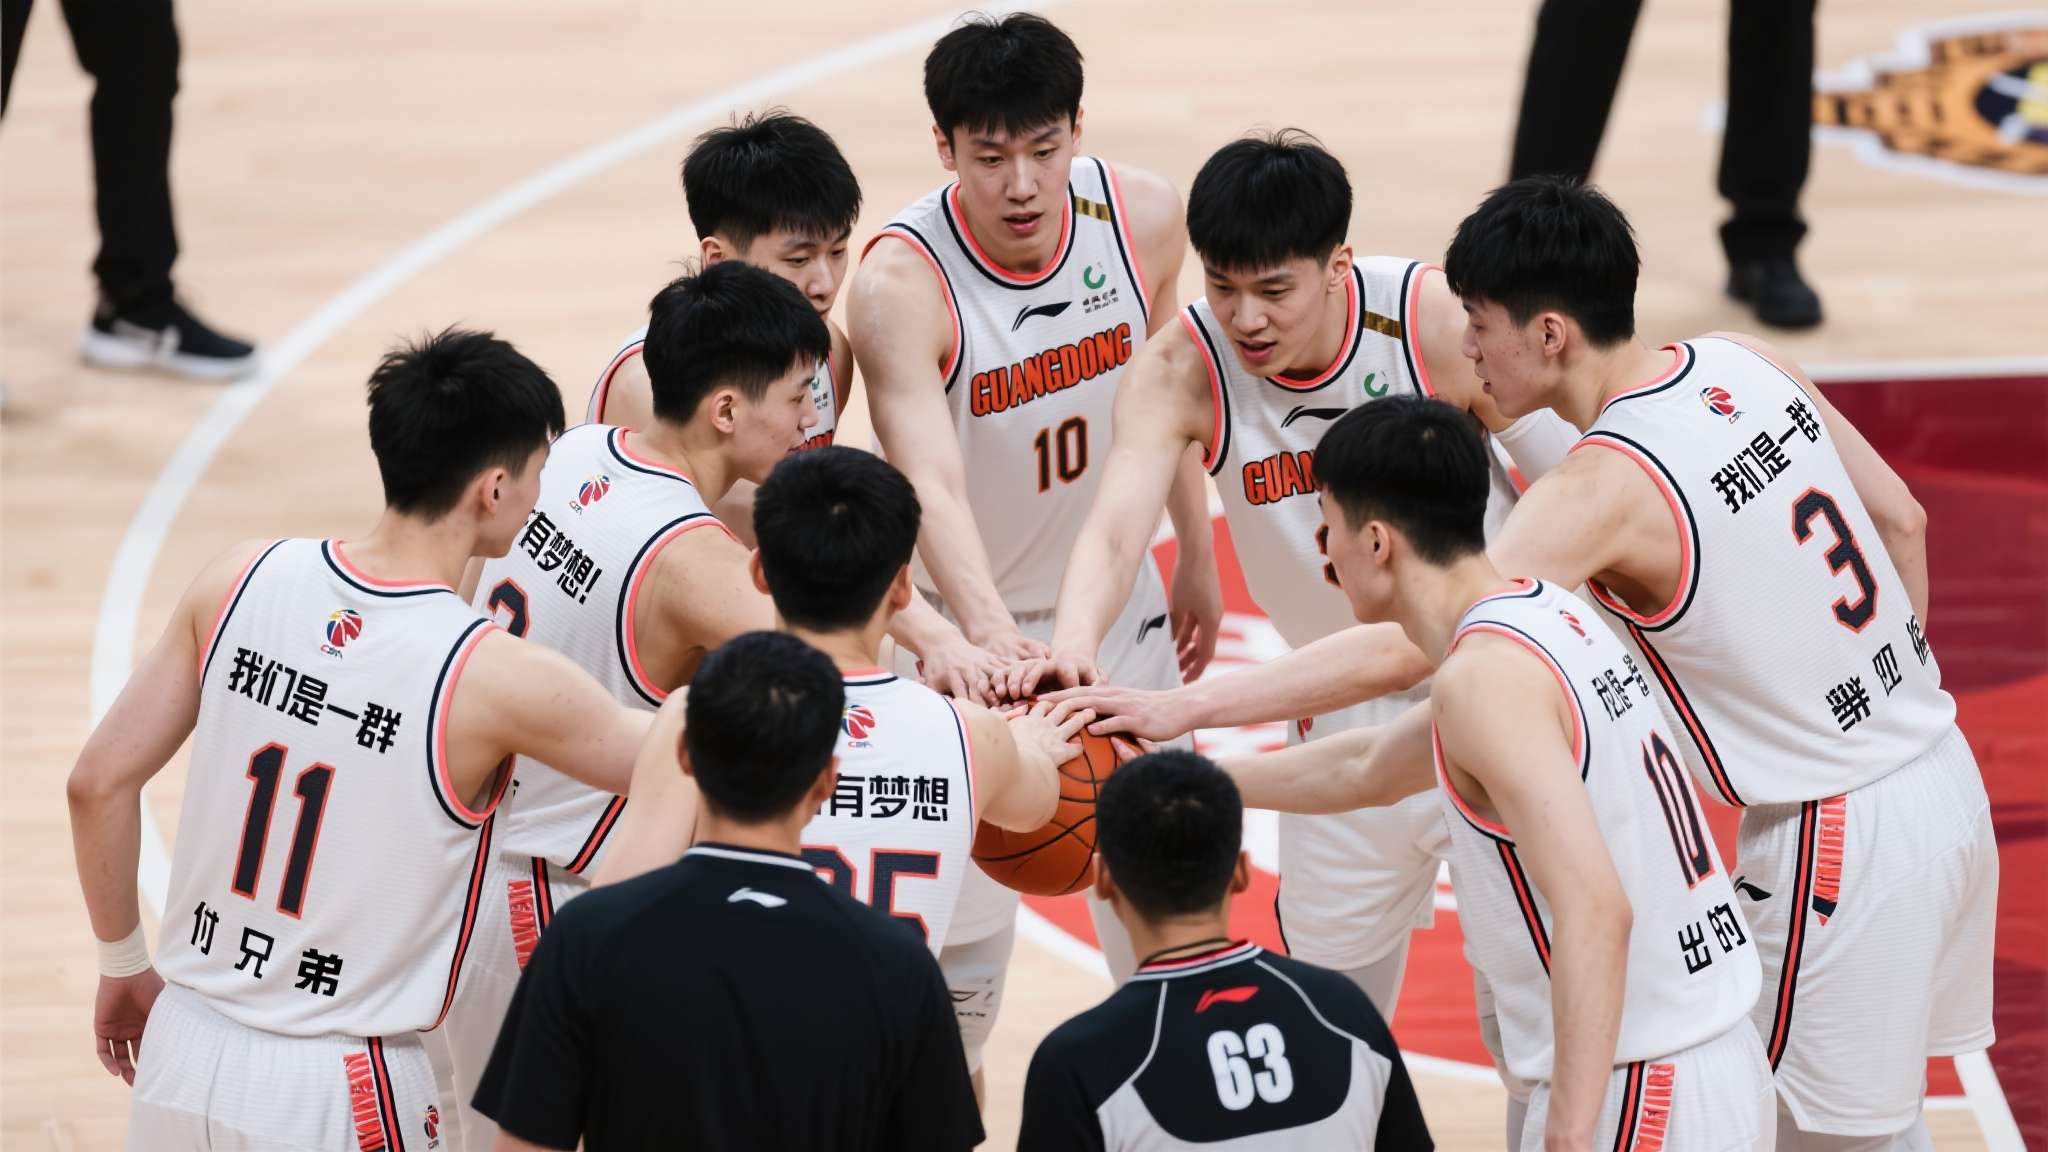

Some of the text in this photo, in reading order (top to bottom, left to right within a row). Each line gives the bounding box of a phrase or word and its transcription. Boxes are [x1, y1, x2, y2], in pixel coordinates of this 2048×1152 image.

[970, 322, 1132, 417] GUANGDONG
[1034, 416, 1088, 494] 10
[1710, 397, 1821, 514] 我们是一群
[1791, 486, 1879, 634] 3
[228, 647, 402, 754] 我们是一群
[231, 741, 335, 921] 11
[816, 773, 949, 822] 有梦想
[1640, 729, 1716, 892] 10
[1206, 1022, 1294, 1111] 63
